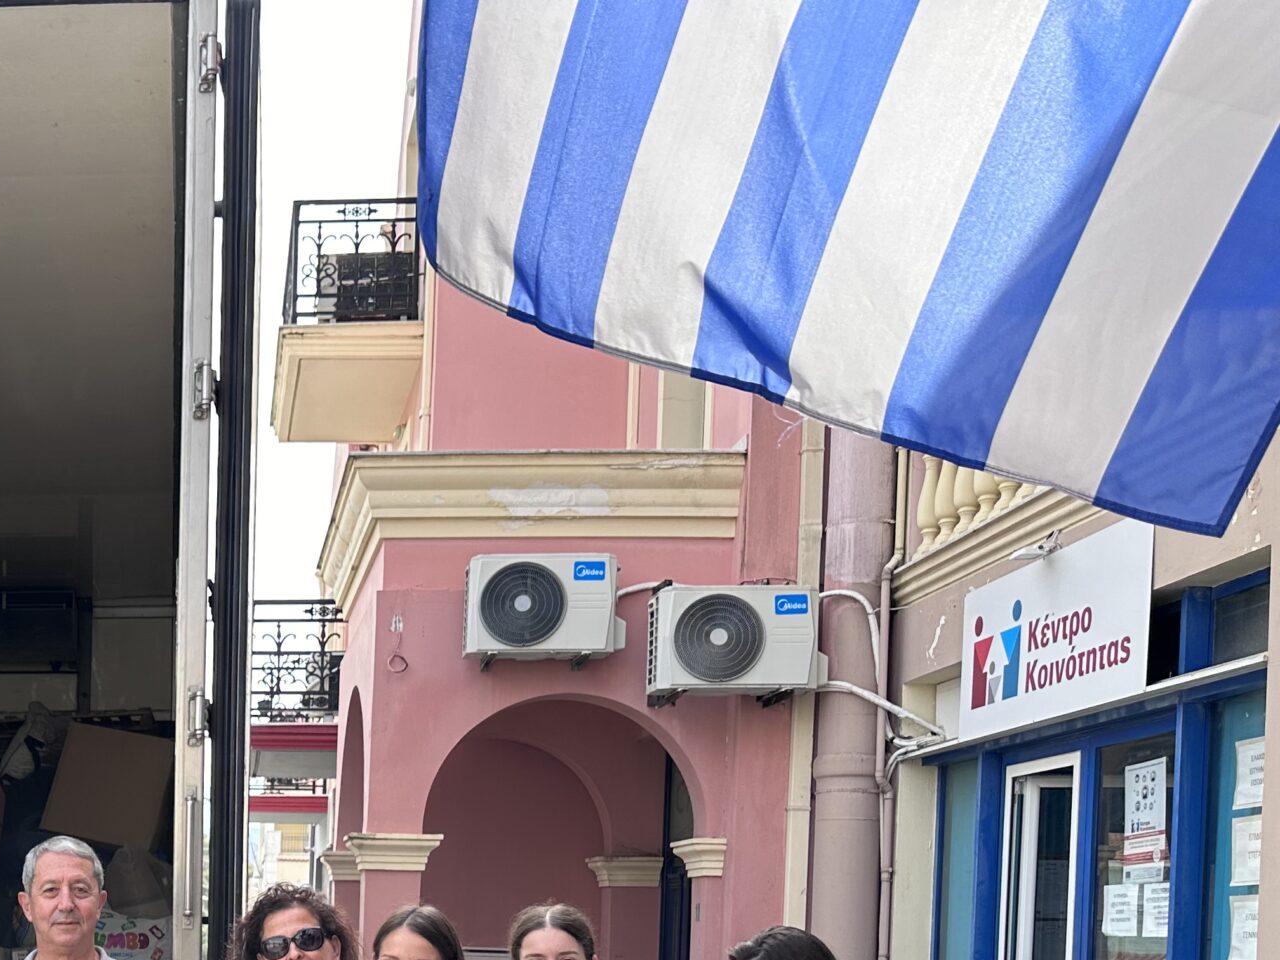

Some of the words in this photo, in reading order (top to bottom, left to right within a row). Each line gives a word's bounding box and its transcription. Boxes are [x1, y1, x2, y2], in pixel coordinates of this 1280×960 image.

[1027, 606, 1092, 653] Κέντρο
[1024, 635, 1132, 693] Κοινότητας
[94, 931, 150, 950] UMBO
